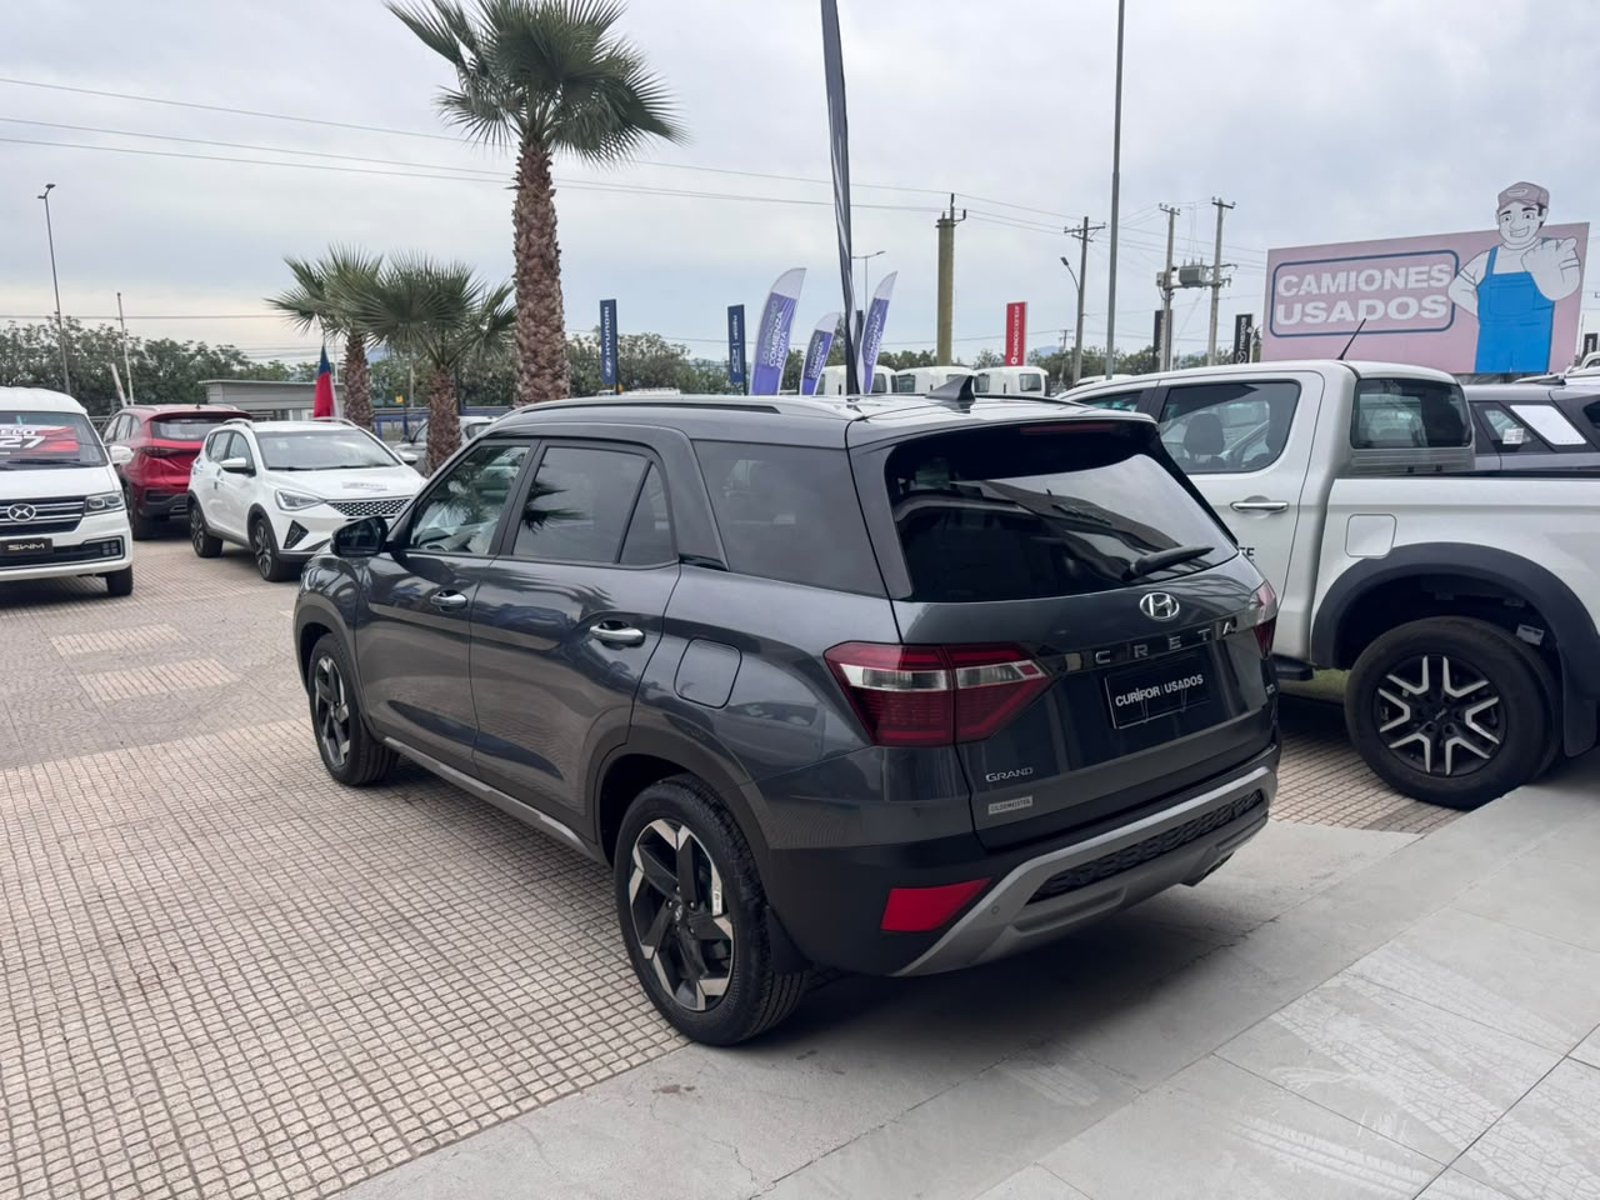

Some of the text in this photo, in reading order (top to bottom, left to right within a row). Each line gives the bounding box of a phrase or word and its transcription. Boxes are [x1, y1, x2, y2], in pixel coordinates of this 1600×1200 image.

[1277, 264, 1450, 297] CAMIONES
[1276, 295, 1448, 325] USADOS
[769, 311, 784, 367] COMIENZA
[776, 331, 788, 370] AHORA
[8, 543, 45, 551] SWM
[1095, 621, 1237, 665] CRETA
[1164, 674, 1204, 694] USADOS
[985, 767, 1033, 782] GRAND
